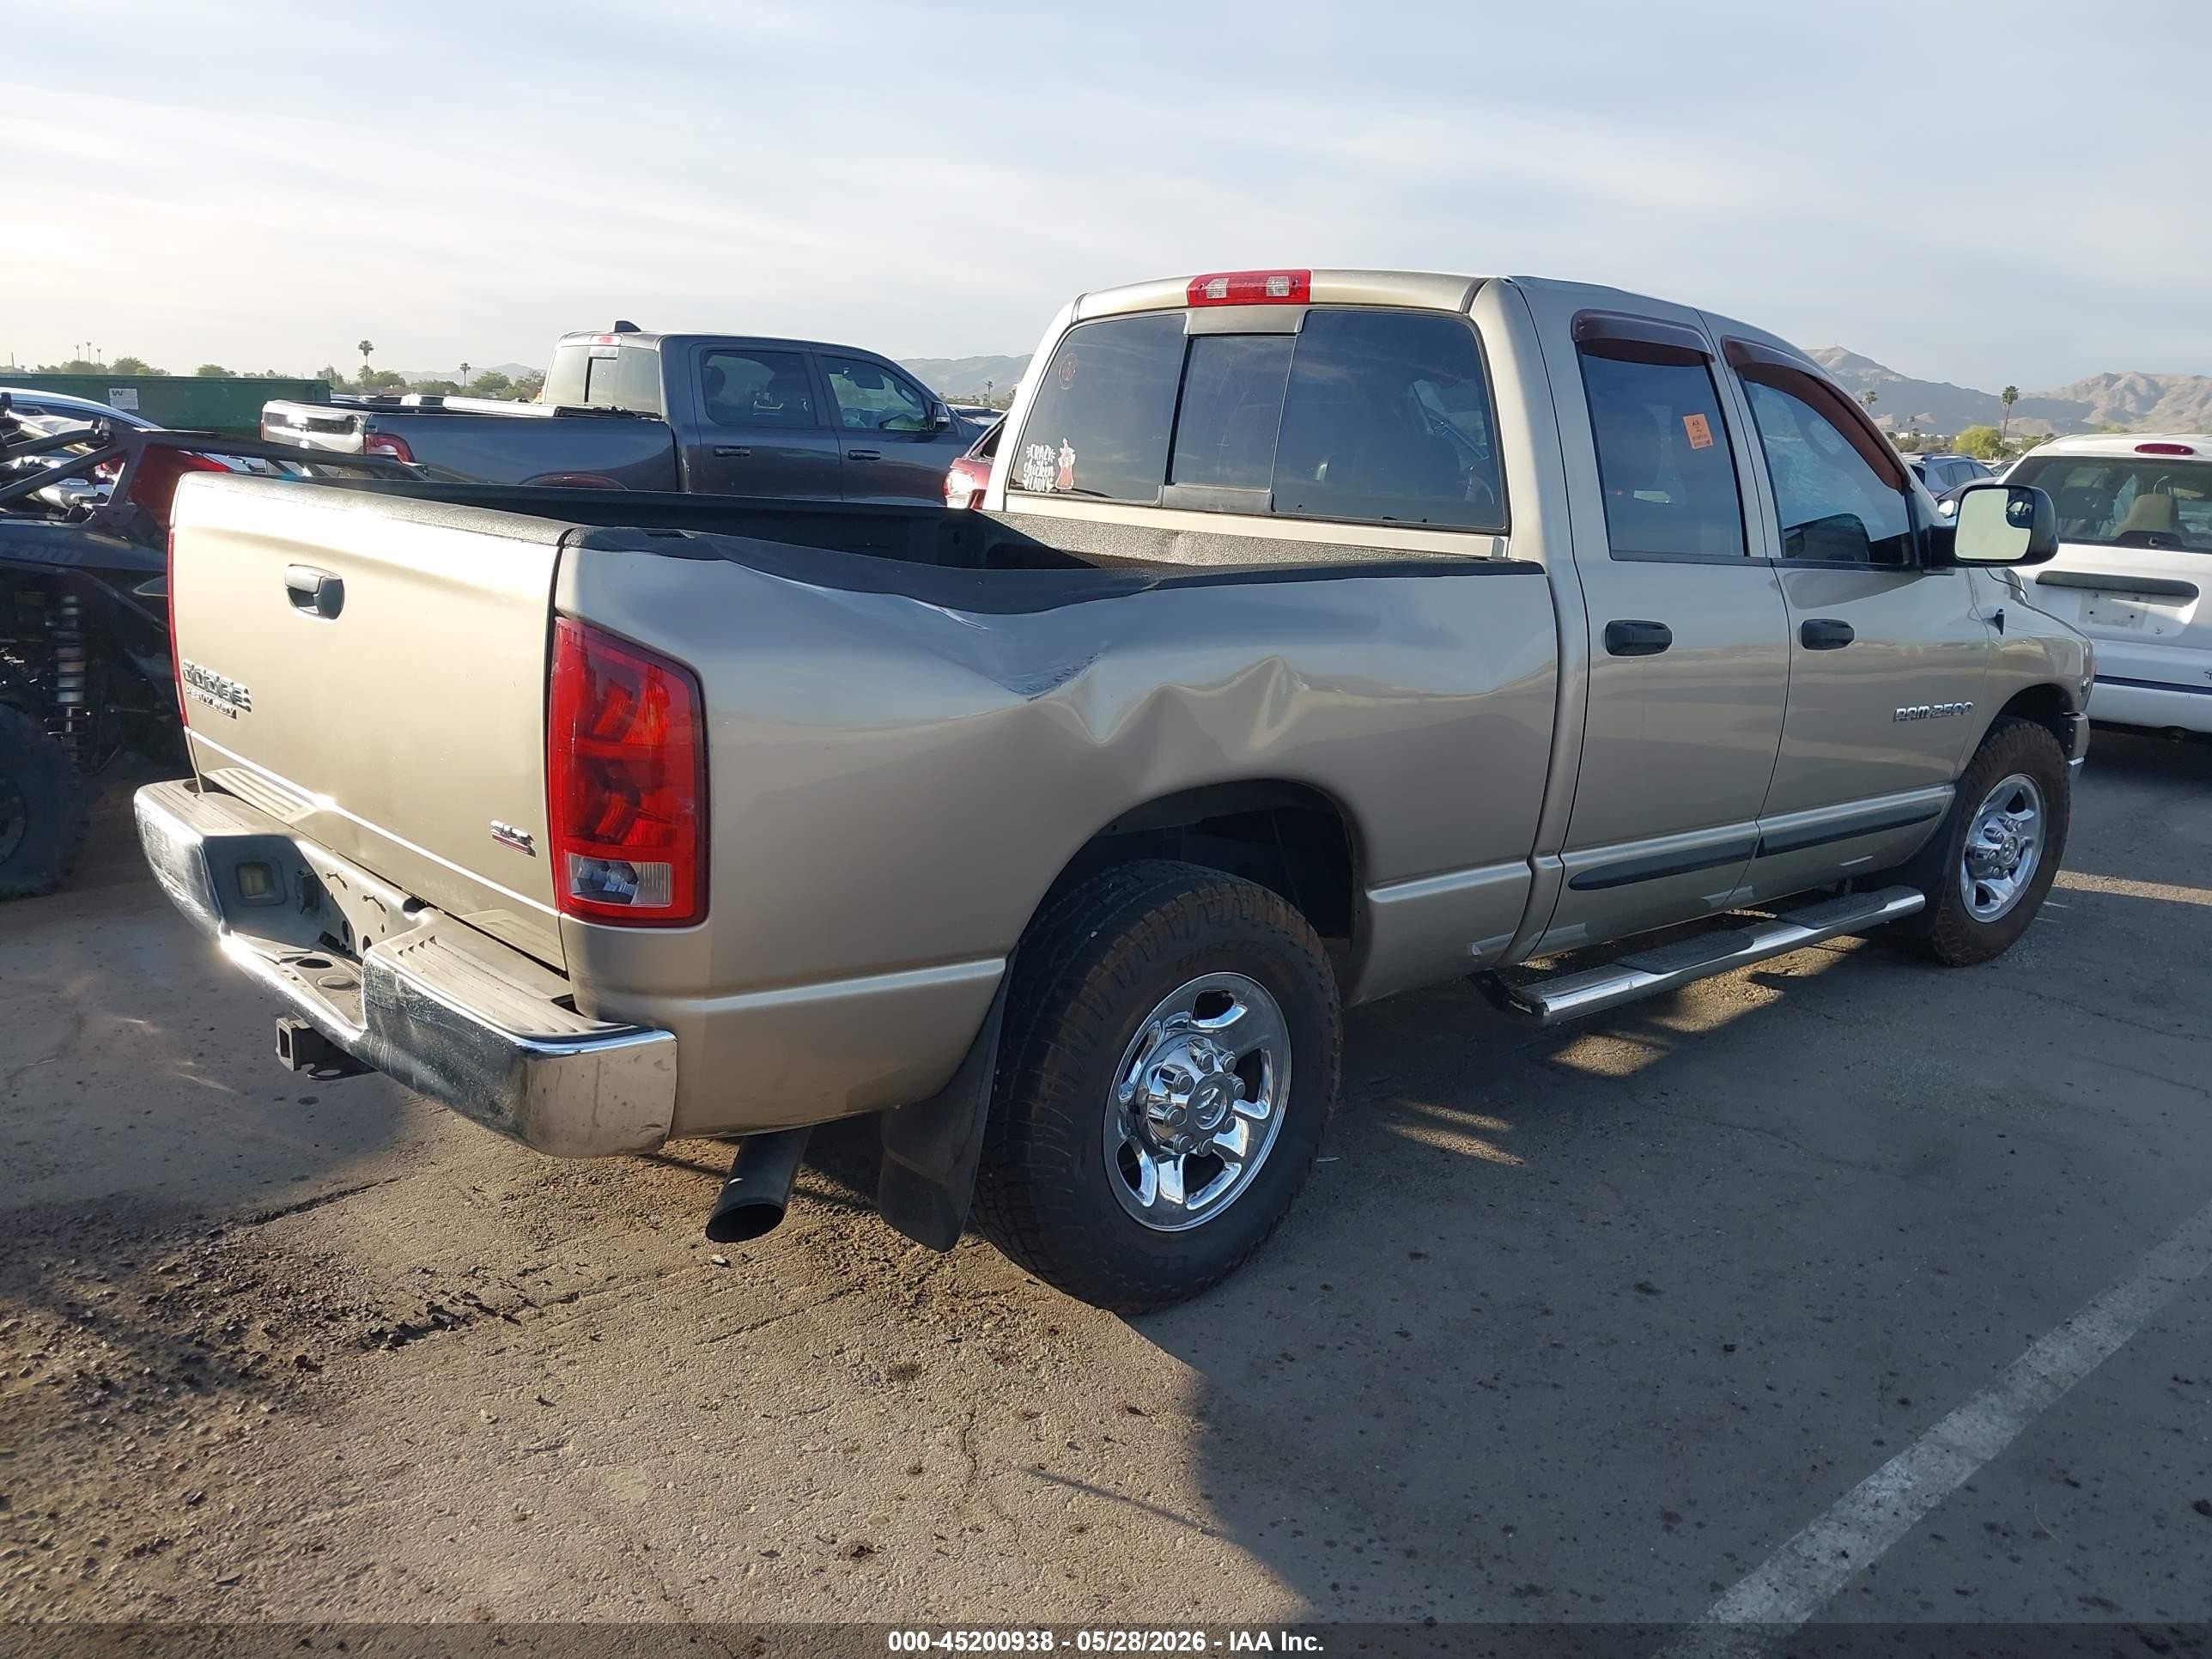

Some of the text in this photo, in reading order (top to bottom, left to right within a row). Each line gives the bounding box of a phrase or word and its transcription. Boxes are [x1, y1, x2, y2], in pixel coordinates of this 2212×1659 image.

[1030, 443, 1053, 463] CRAZY
[1023, 458, 1054, 477] chicken
[1028, 474, 1048, 492] LADY
[181, 659, 252, 714] DODGE
[1893, 702, 1973, 722] RAM 2500
